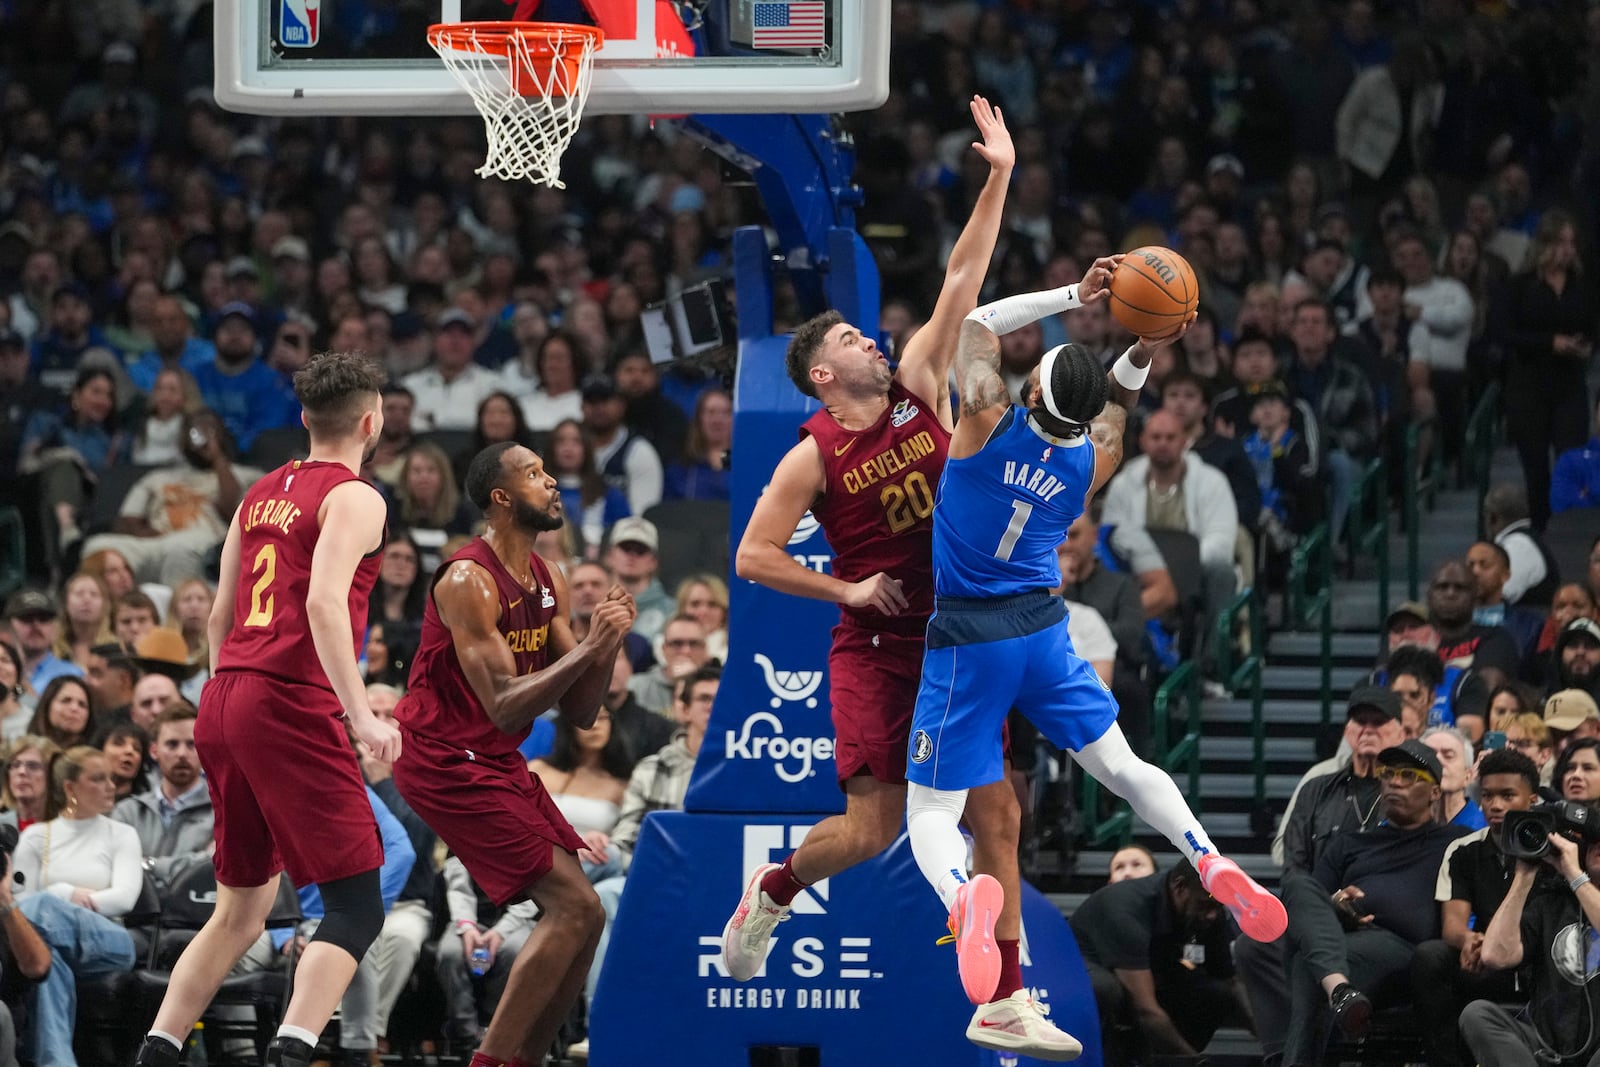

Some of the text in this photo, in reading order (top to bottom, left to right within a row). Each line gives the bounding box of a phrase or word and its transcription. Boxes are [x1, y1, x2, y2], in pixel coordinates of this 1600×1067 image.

[285, 26, 304, 41] NBA
[892, 406, 918, 426] CLIFFS
[842, 430, 936, 494] CLEVELAND
[1003, 460, 1067, 502] HARDY
[244, 499, 302, 535] JEROME
[880, 470, 934, 533] 20
[993, 498, 1034, 562] 1
[243, 543, 277, 627] 2
[505, 623, 550, 653] CLEVE
[725, 711, 838, 783] Kroge
[706, 988, 861, 1009] ENERGY DRINK
